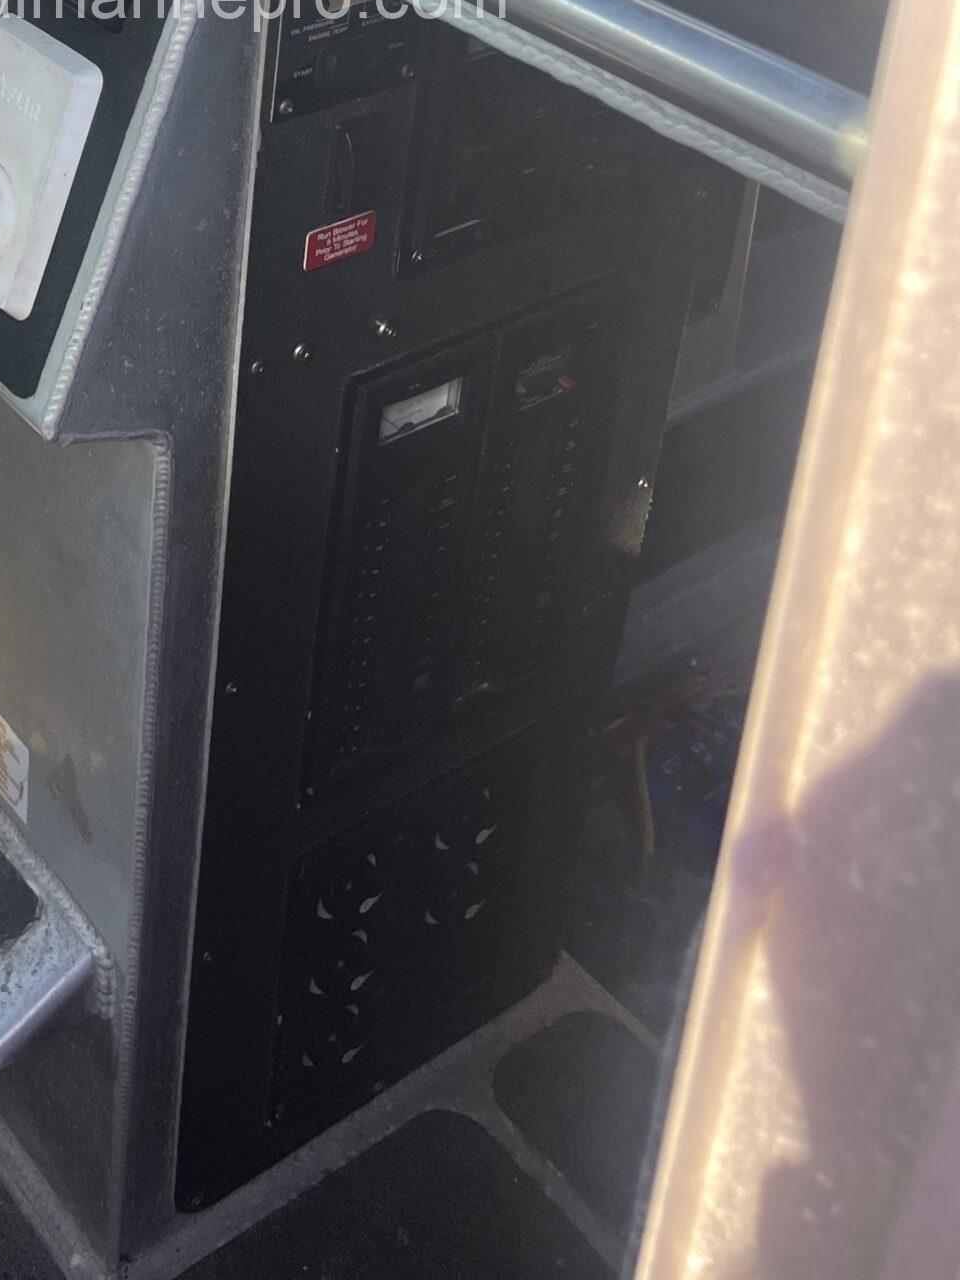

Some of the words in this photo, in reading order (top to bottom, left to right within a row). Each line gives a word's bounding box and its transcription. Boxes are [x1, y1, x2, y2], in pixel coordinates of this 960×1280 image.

[317, 232, 331, 242] Run
[332, 222, 356, 237] Blower
[356, 218, 369, 228] For
[332, 230, 359, 244] Minutes
[315, 246, 332, 257] Prior
[342, 234, 368, 248] Starting
[323, 245, 358, 262] Generator
